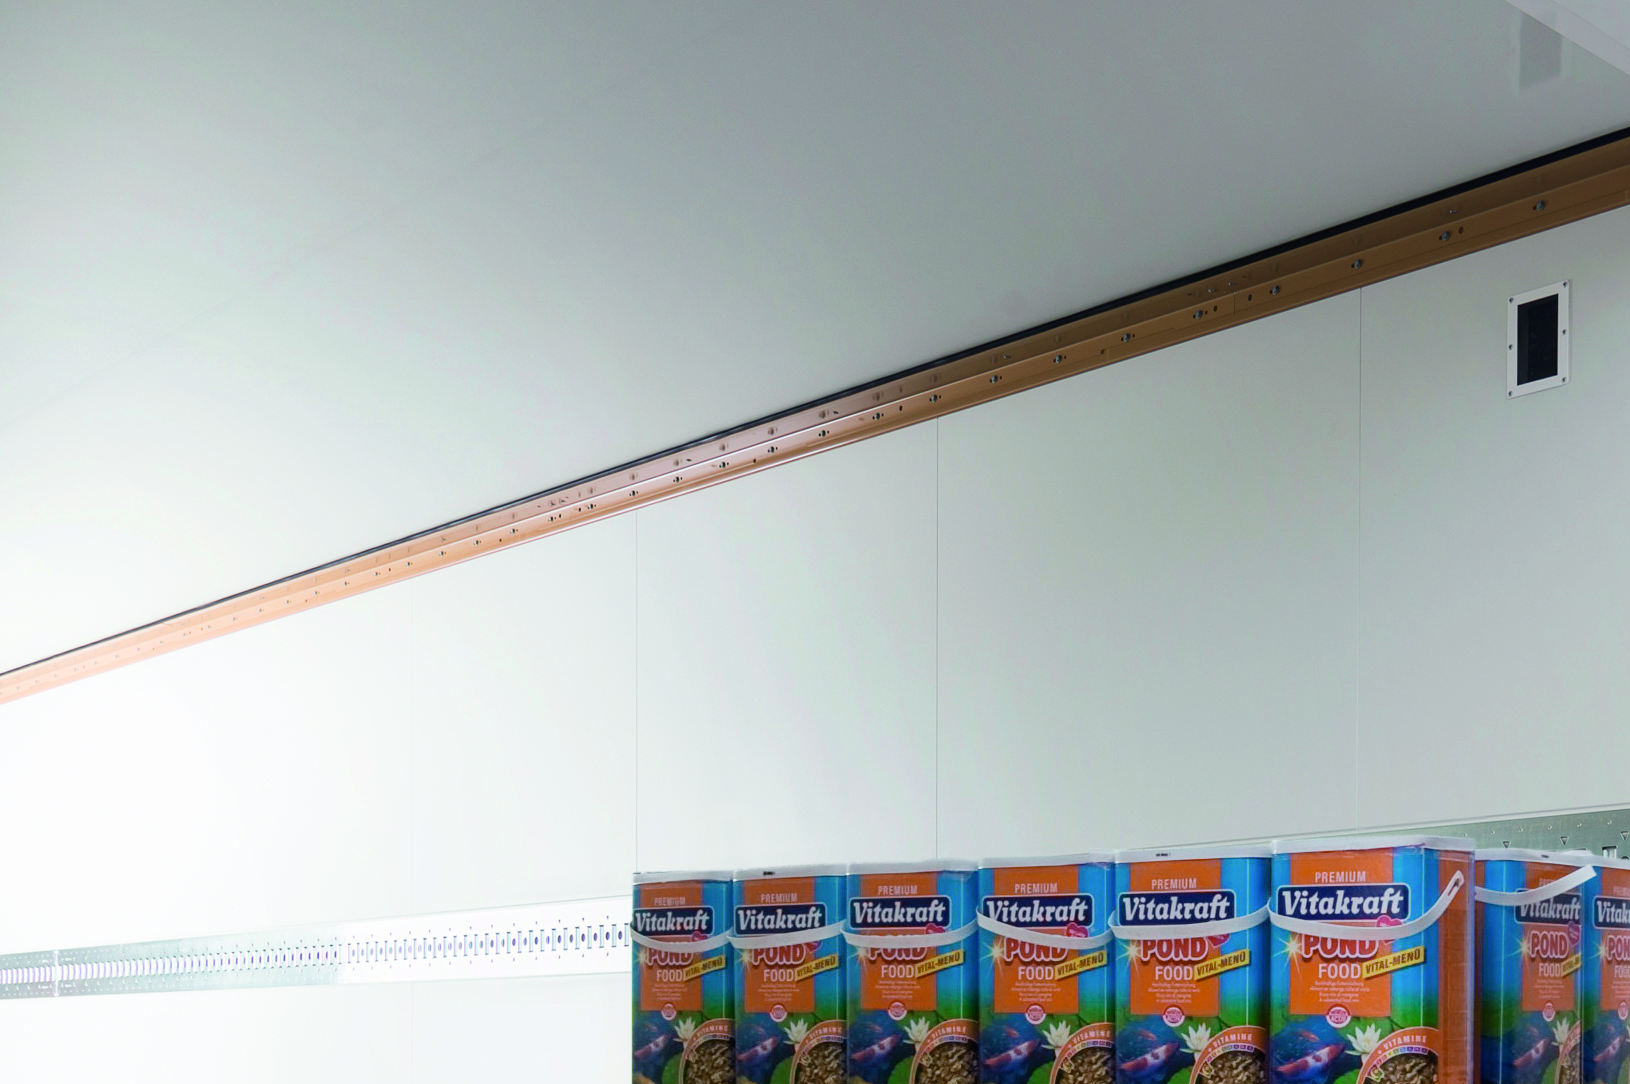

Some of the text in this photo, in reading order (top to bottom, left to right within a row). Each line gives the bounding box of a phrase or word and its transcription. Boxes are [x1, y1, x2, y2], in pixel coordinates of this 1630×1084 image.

[1152, 878, 1197, 890] PREMIUM
[1315, 871, 1366, 883] PREMIUM
[760, 893, 798, 903] PREMIUM
[878, 885, 918, 895] PREMIUM
[1014, 883, 1058, 894] PREMIUM
[853, 899, 946, 924] Vitakraft
[986, 897, 1088, 923] Vitakraft
[1122, 894, 1230, 921] Vitakraft
[1282, 888, 1404, 916] Vitakraft
[1520, 897, 1581, 920] Vitakraft
[635, 909, 709, 932] Vitakraft
[738, 904, 822, 930] Vitakraft
[752, 943, 807, 965] POND
[1003, 937, 1068, 962] POND
[1141, 938, 1208, 962] POND
[1303, 935, 1378, 959] POND
[1529, 930, 1569, 960] POND
[656, 970, 686, 982] FOOD
[764, 970, 798, 982] FOOD
[881, 965, 914, 978] FOOD
[1018, 966, 1054, 980] FOOD
[1154, 966, 1193, 981] FOOD
[1318, 963, 1361, 979] FOOD
[1538, 963, 1561, 978] FOOD
